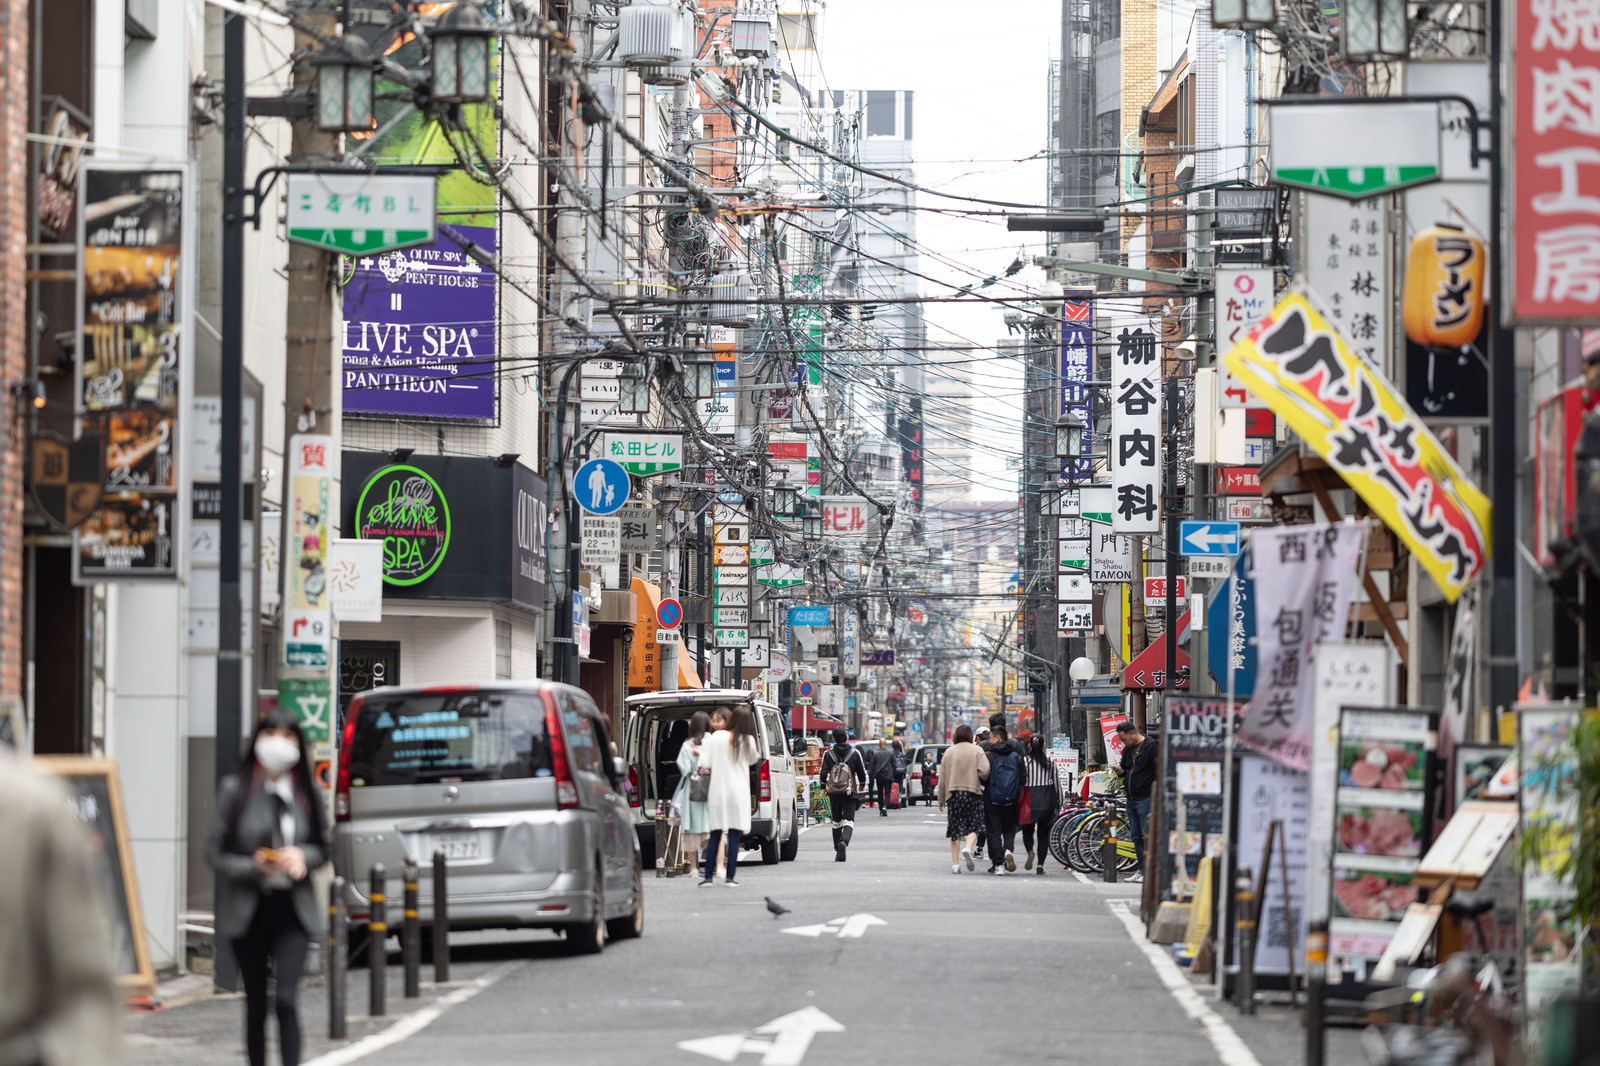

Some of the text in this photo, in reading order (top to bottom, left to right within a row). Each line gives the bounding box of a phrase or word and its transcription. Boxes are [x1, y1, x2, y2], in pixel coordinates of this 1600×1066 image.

[1531, 0, 1600, 302] 焼肉工房
[1223, 214, 1251, 225] PART
[410, 249, 440, 261] OLIVE
[405, 272, 479, 289] PENT HOUSE
[1435, 236, 1474, 331] ラーメン
[342, 321, 412, 354] LIVE
[345, 371, 447, 394] PANTHEON
[1116, 327, 1158, 523] 柳谷内科
[302, 443, 326, 467] 質
[610, 440, 676, 457] 松田ビル
[367, 480, 438, 525] olive
[1328, 423, 1477, 585] サービス
[622, 522, 649, 539] 科
[383, 537, 425, 568] SPA
[1094, 557, 1114, 565] Shabu
[1094, 571, 1131, 579] TAMON
[1191, 562, 1229, 573] 自転車を除く
[795, 610, 826, 622] たばこ
[1060, 612, 1092, 627] チョコボ
[313, 621, 323, 636] 9
[657, 632, 680, 641] 自動車
[645, 642, 655, 685] 柳田商店
